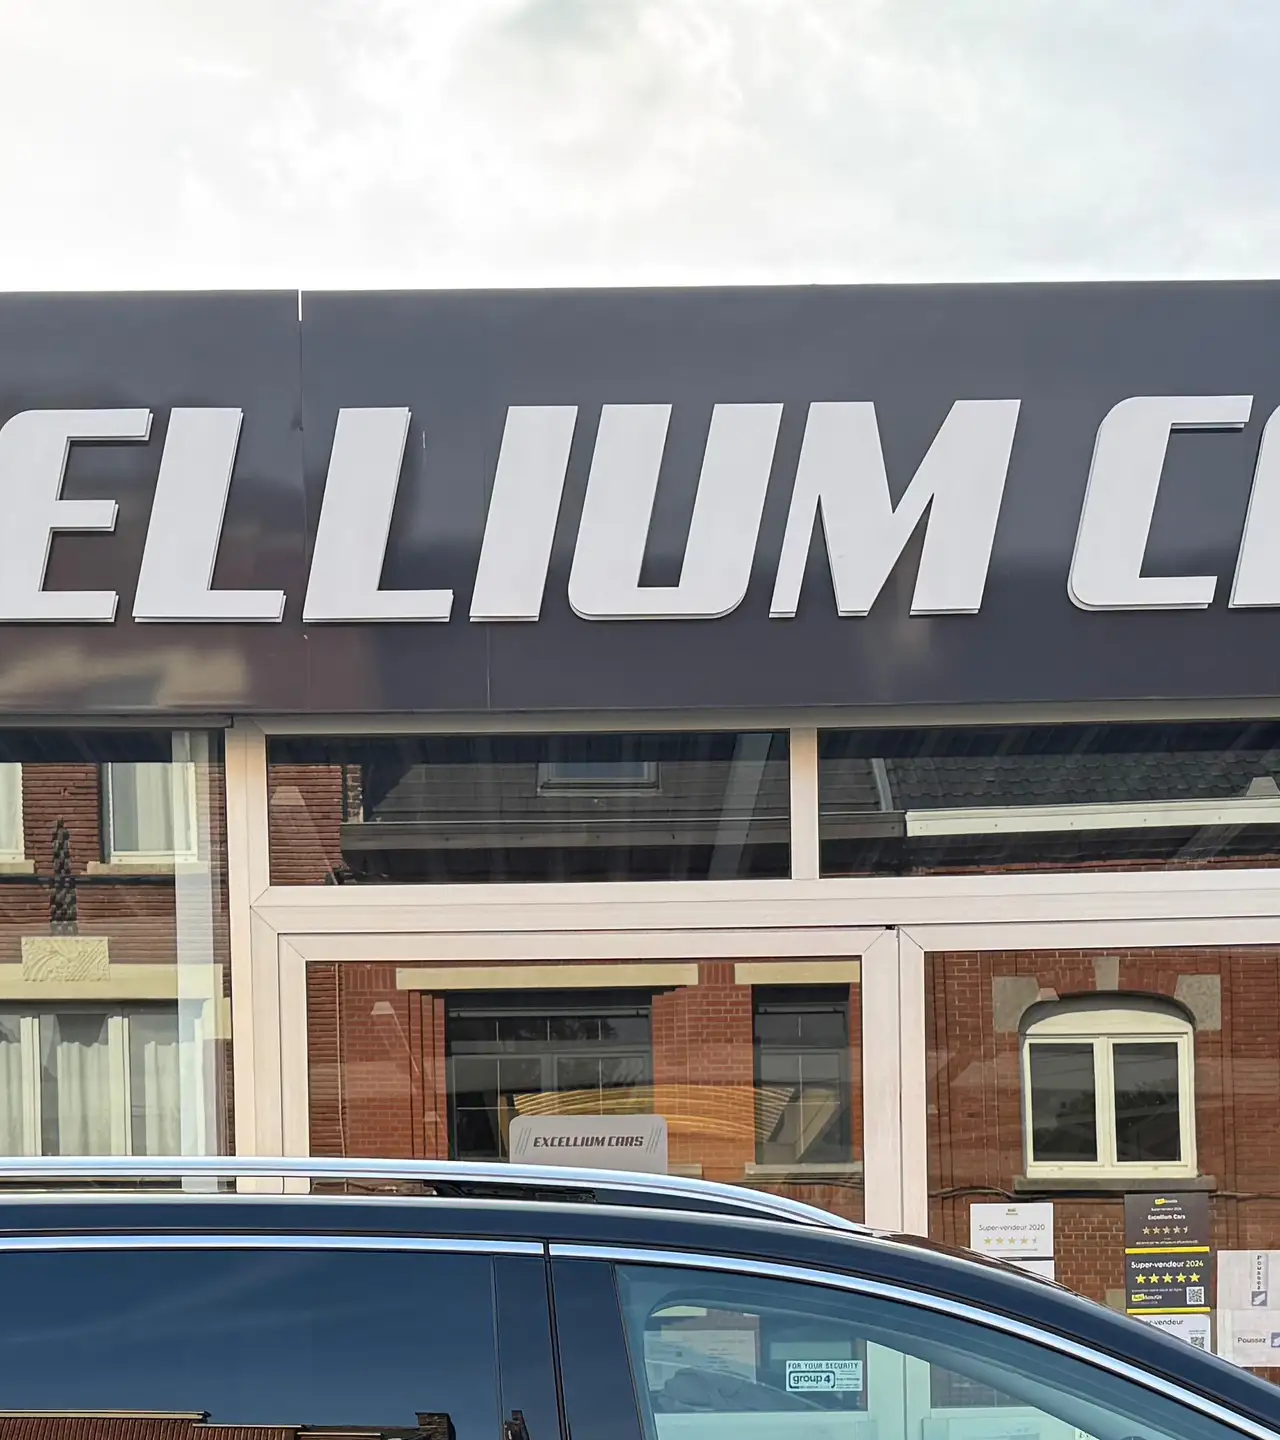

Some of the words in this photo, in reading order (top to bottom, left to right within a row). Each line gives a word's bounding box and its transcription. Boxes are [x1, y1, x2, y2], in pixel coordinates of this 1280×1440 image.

[533, 1136, 606, 1148] EXCELLIUM
[607, 1136, 644, 1147] CARS
[1131, 1260, 1184, 1270] Super-vendeur
[1185, 1260, 1204, 1268] 2024
[788, 1362, 801, 1370] FOR
[804, 1362, 823, 1370] YOUR
[825, 1362, 859, 1370] SECURITY
